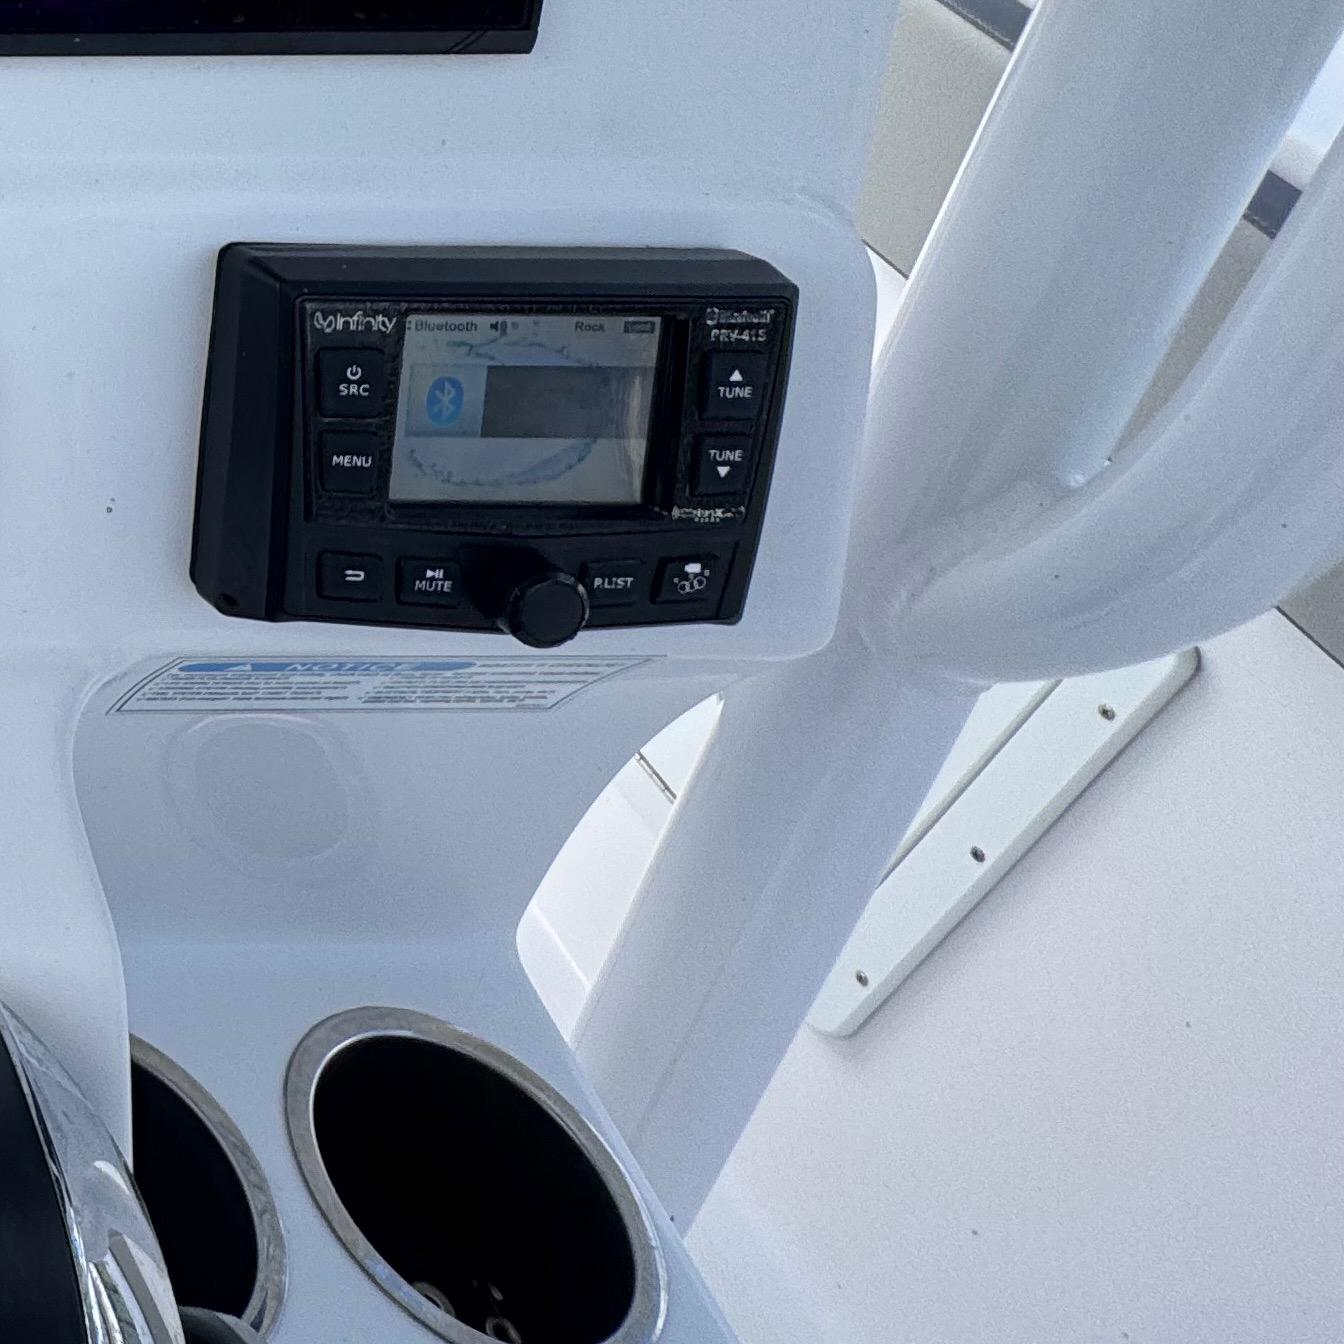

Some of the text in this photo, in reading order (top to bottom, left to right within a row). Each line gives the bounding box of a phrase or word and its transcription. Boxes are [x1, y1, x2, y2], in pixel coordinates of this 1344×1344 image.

[415, 320, 605, 332] Bluetooth Rock
[339, 384, 370, 396] SRC
[717, 385, 753, 399] TUNE
[332, 455, 372, 468] MENU
[709, 449, 743, 463] TUNE
[414, 578, 452, 593] MUTE
